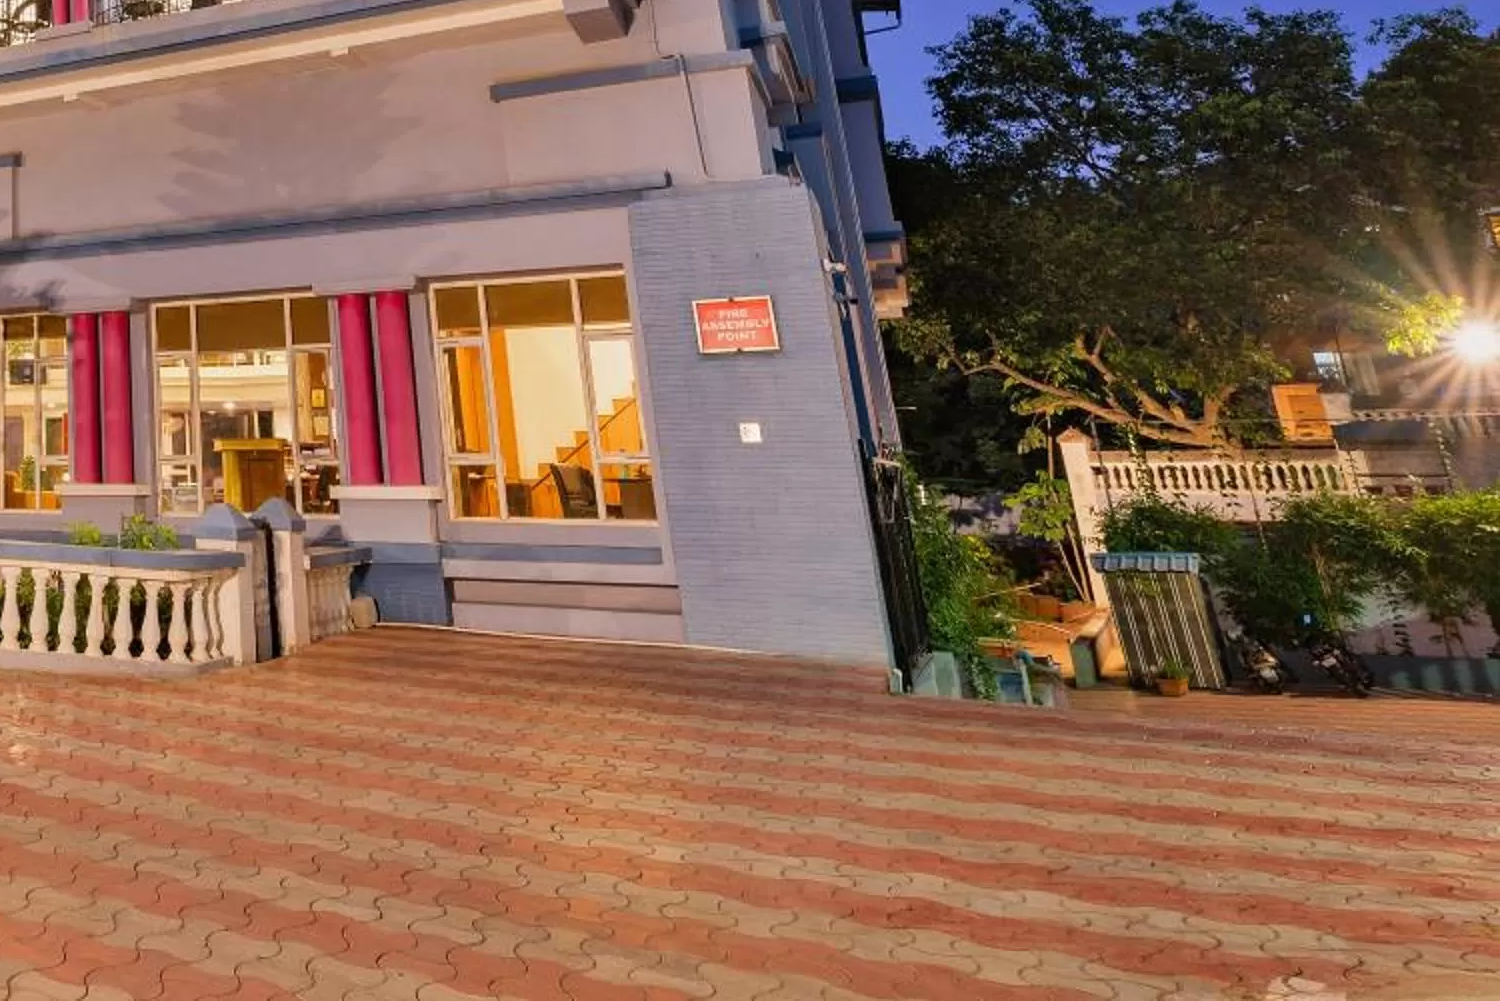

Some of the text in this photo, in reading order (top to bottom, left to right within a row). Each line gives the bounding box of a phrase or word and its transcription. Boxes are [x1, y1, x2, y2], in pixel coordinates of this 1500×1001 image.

[719, 309, 749, 320] FIRE
[702, 318, 770, 330] ASSEMBLY
[717, 330, 757, 341] POINT
